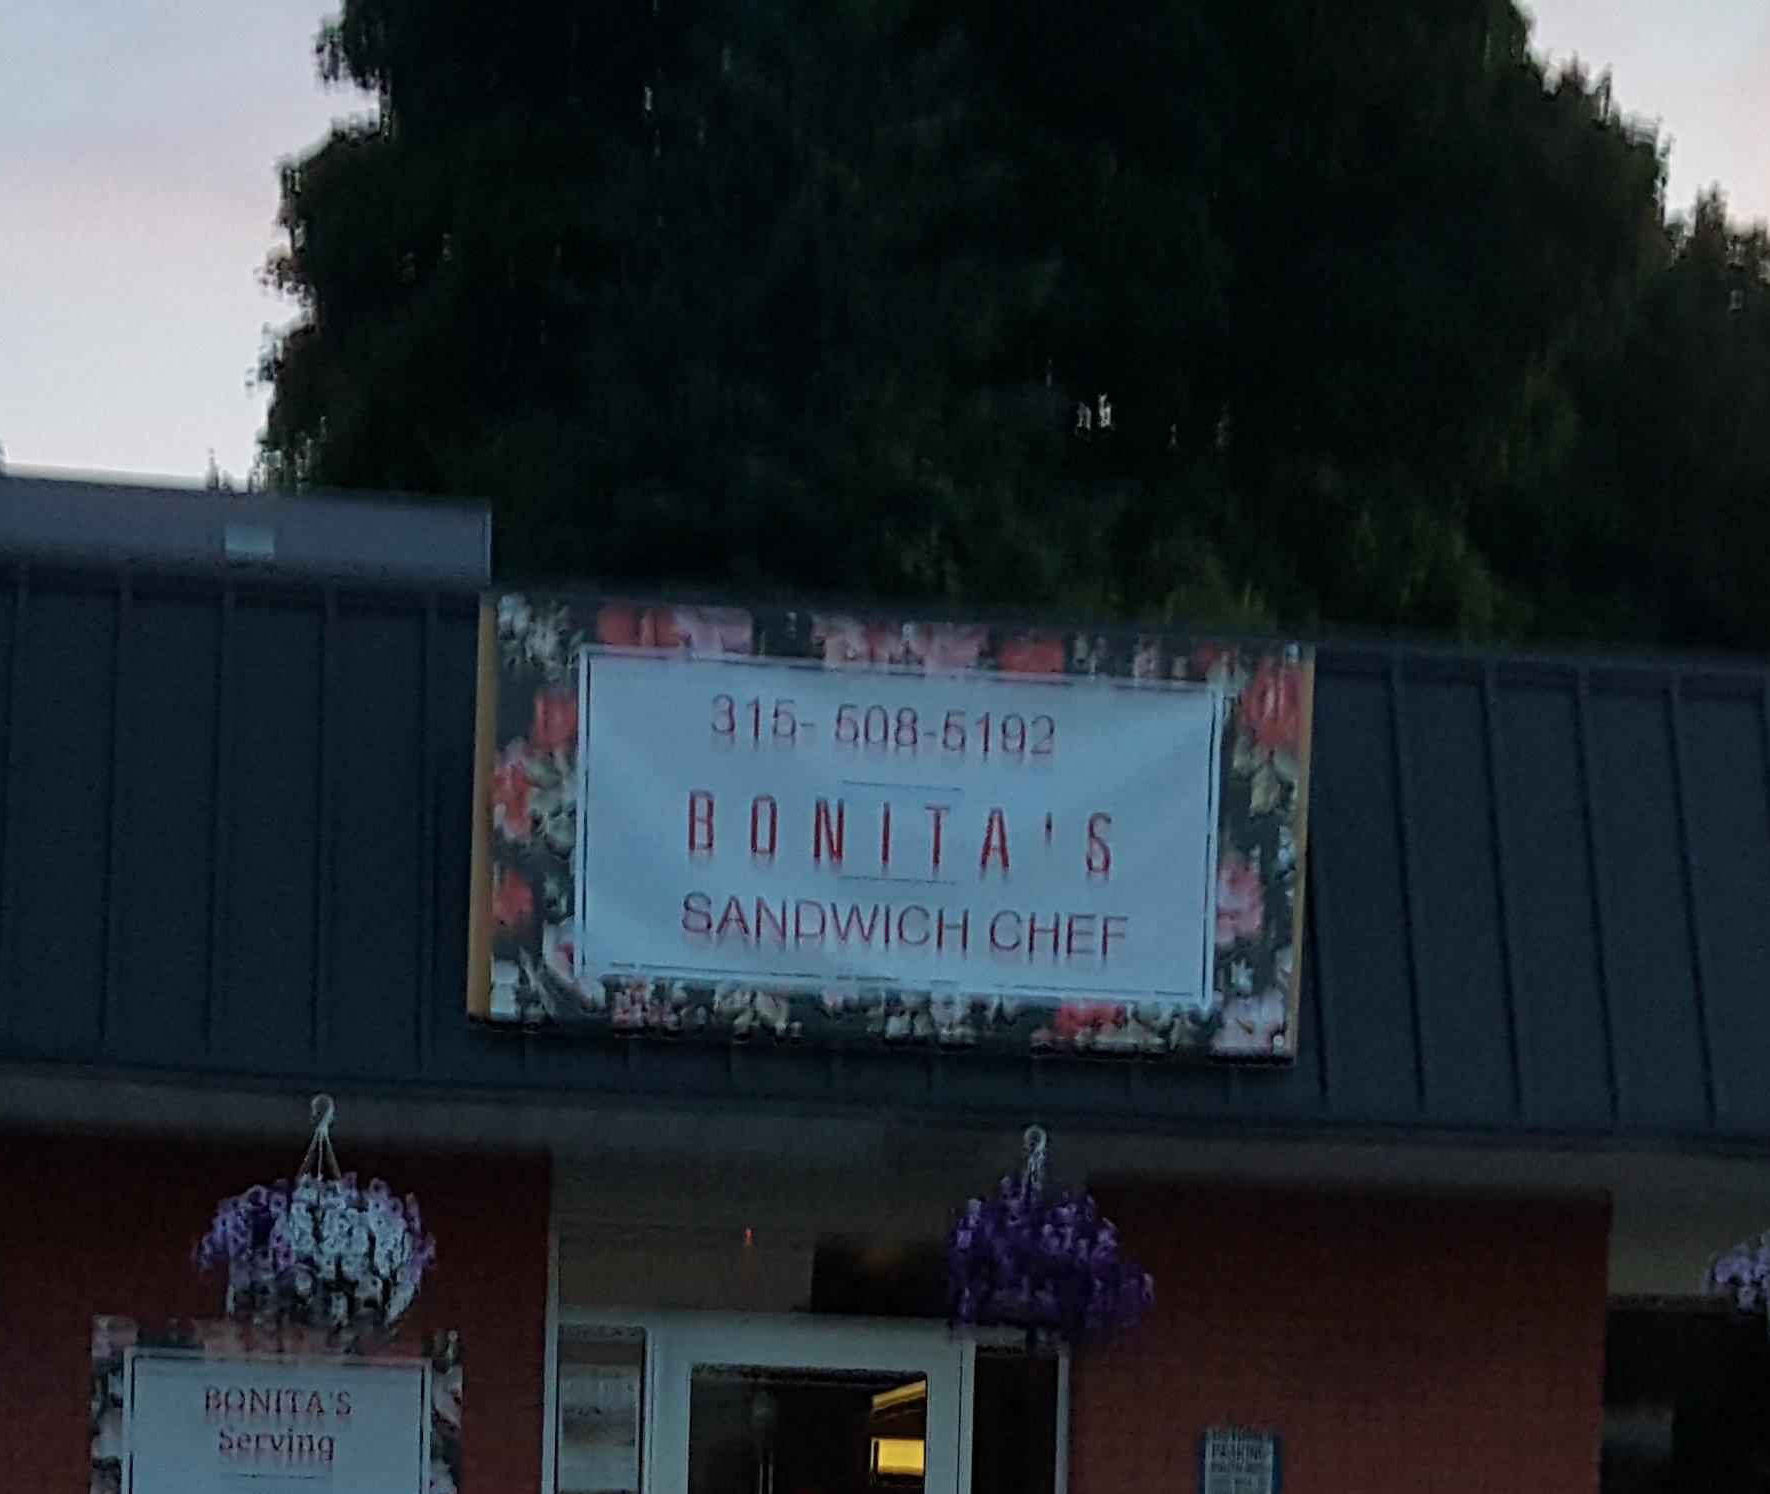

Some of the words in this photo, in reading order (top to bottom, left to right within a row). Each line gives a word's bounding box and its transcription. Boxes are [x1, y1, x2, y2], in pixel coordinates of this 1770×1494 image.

[688, 792, 1113, 874] BONITA'S
[681, 892, 970, 954] SANDWICH
[988, 909, 1130, 959] CHEF
[204, 1386, 353, 1419] BONITA'S
[218, 1428, 336, 1463] Serving
